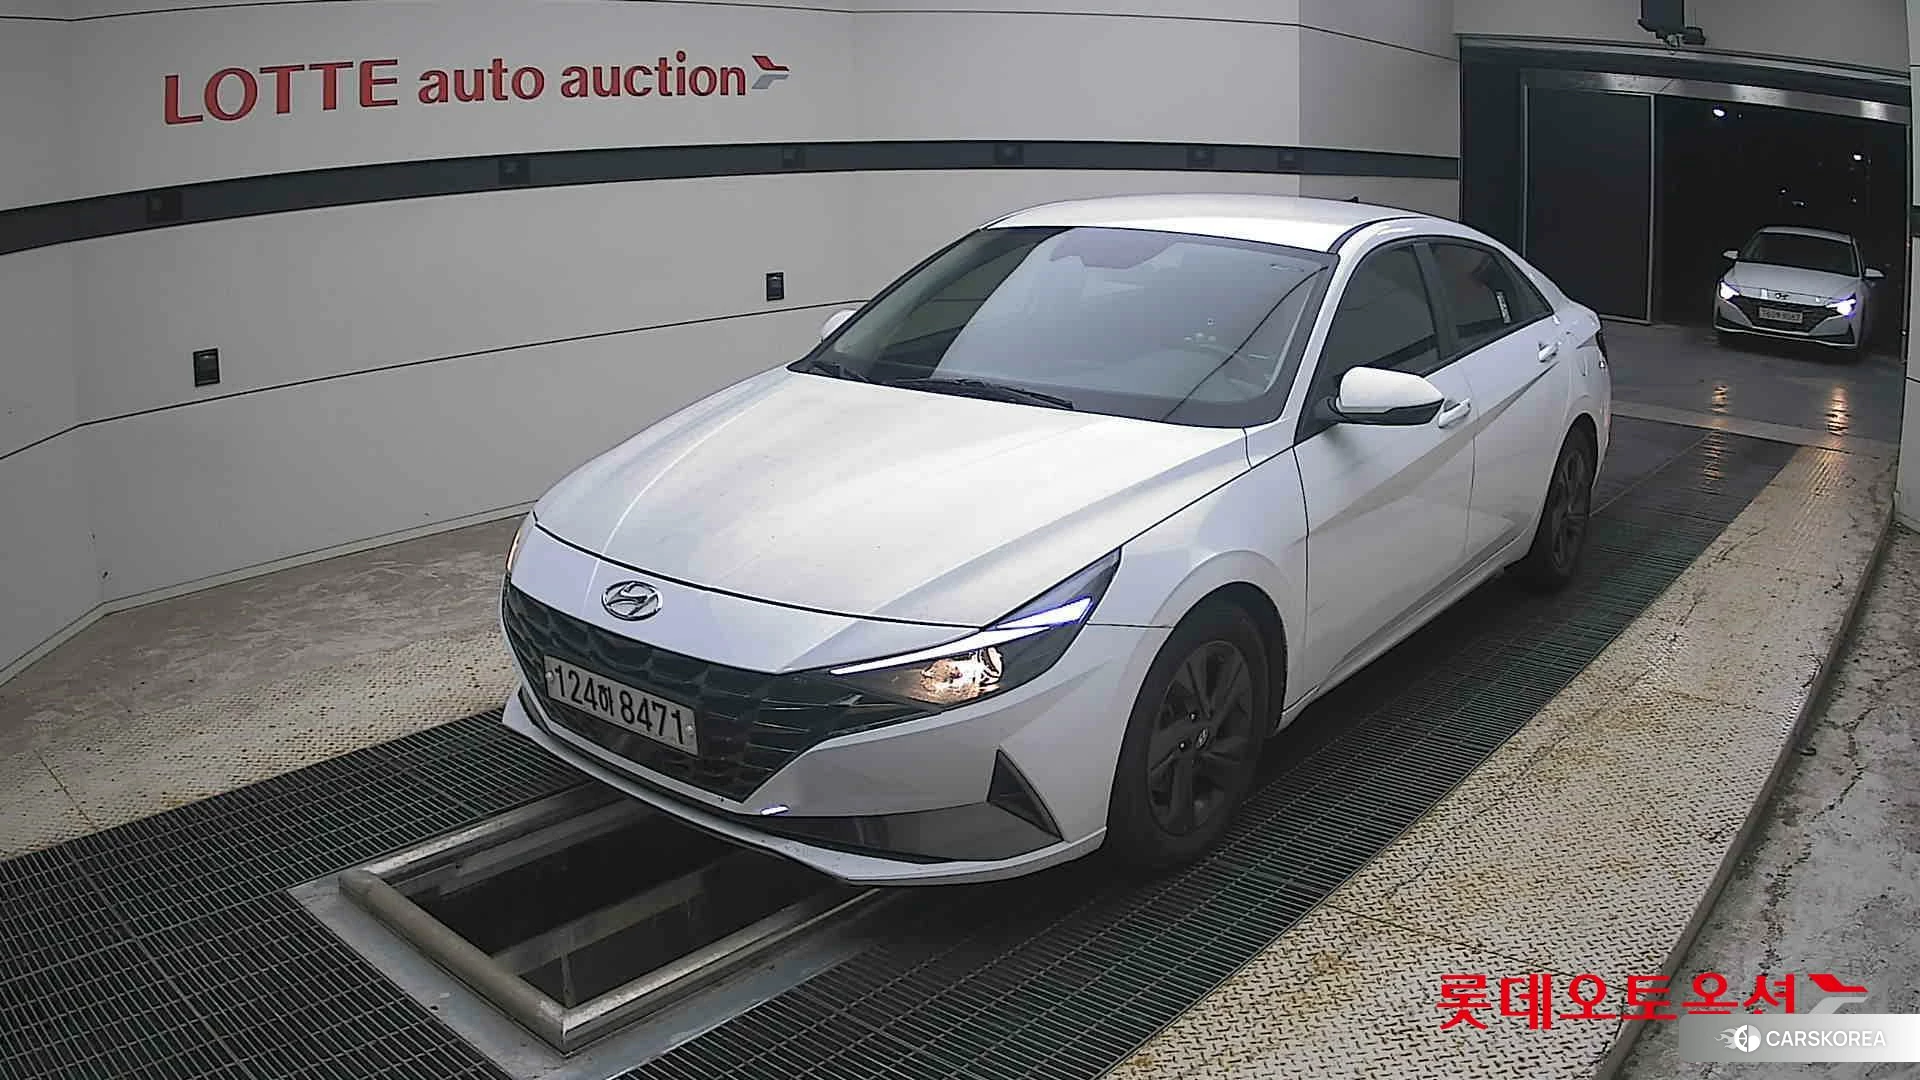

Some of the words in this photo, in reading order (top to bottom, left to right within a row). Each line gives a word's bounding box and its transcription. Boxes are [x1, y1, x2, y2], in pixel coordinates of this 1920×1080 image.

[164, 58, 399, 126] LOTTE
[418, 57, 545, 104] auto
[560, 50, 746, 98] auction
[619, 690, 684, 745] 8471
